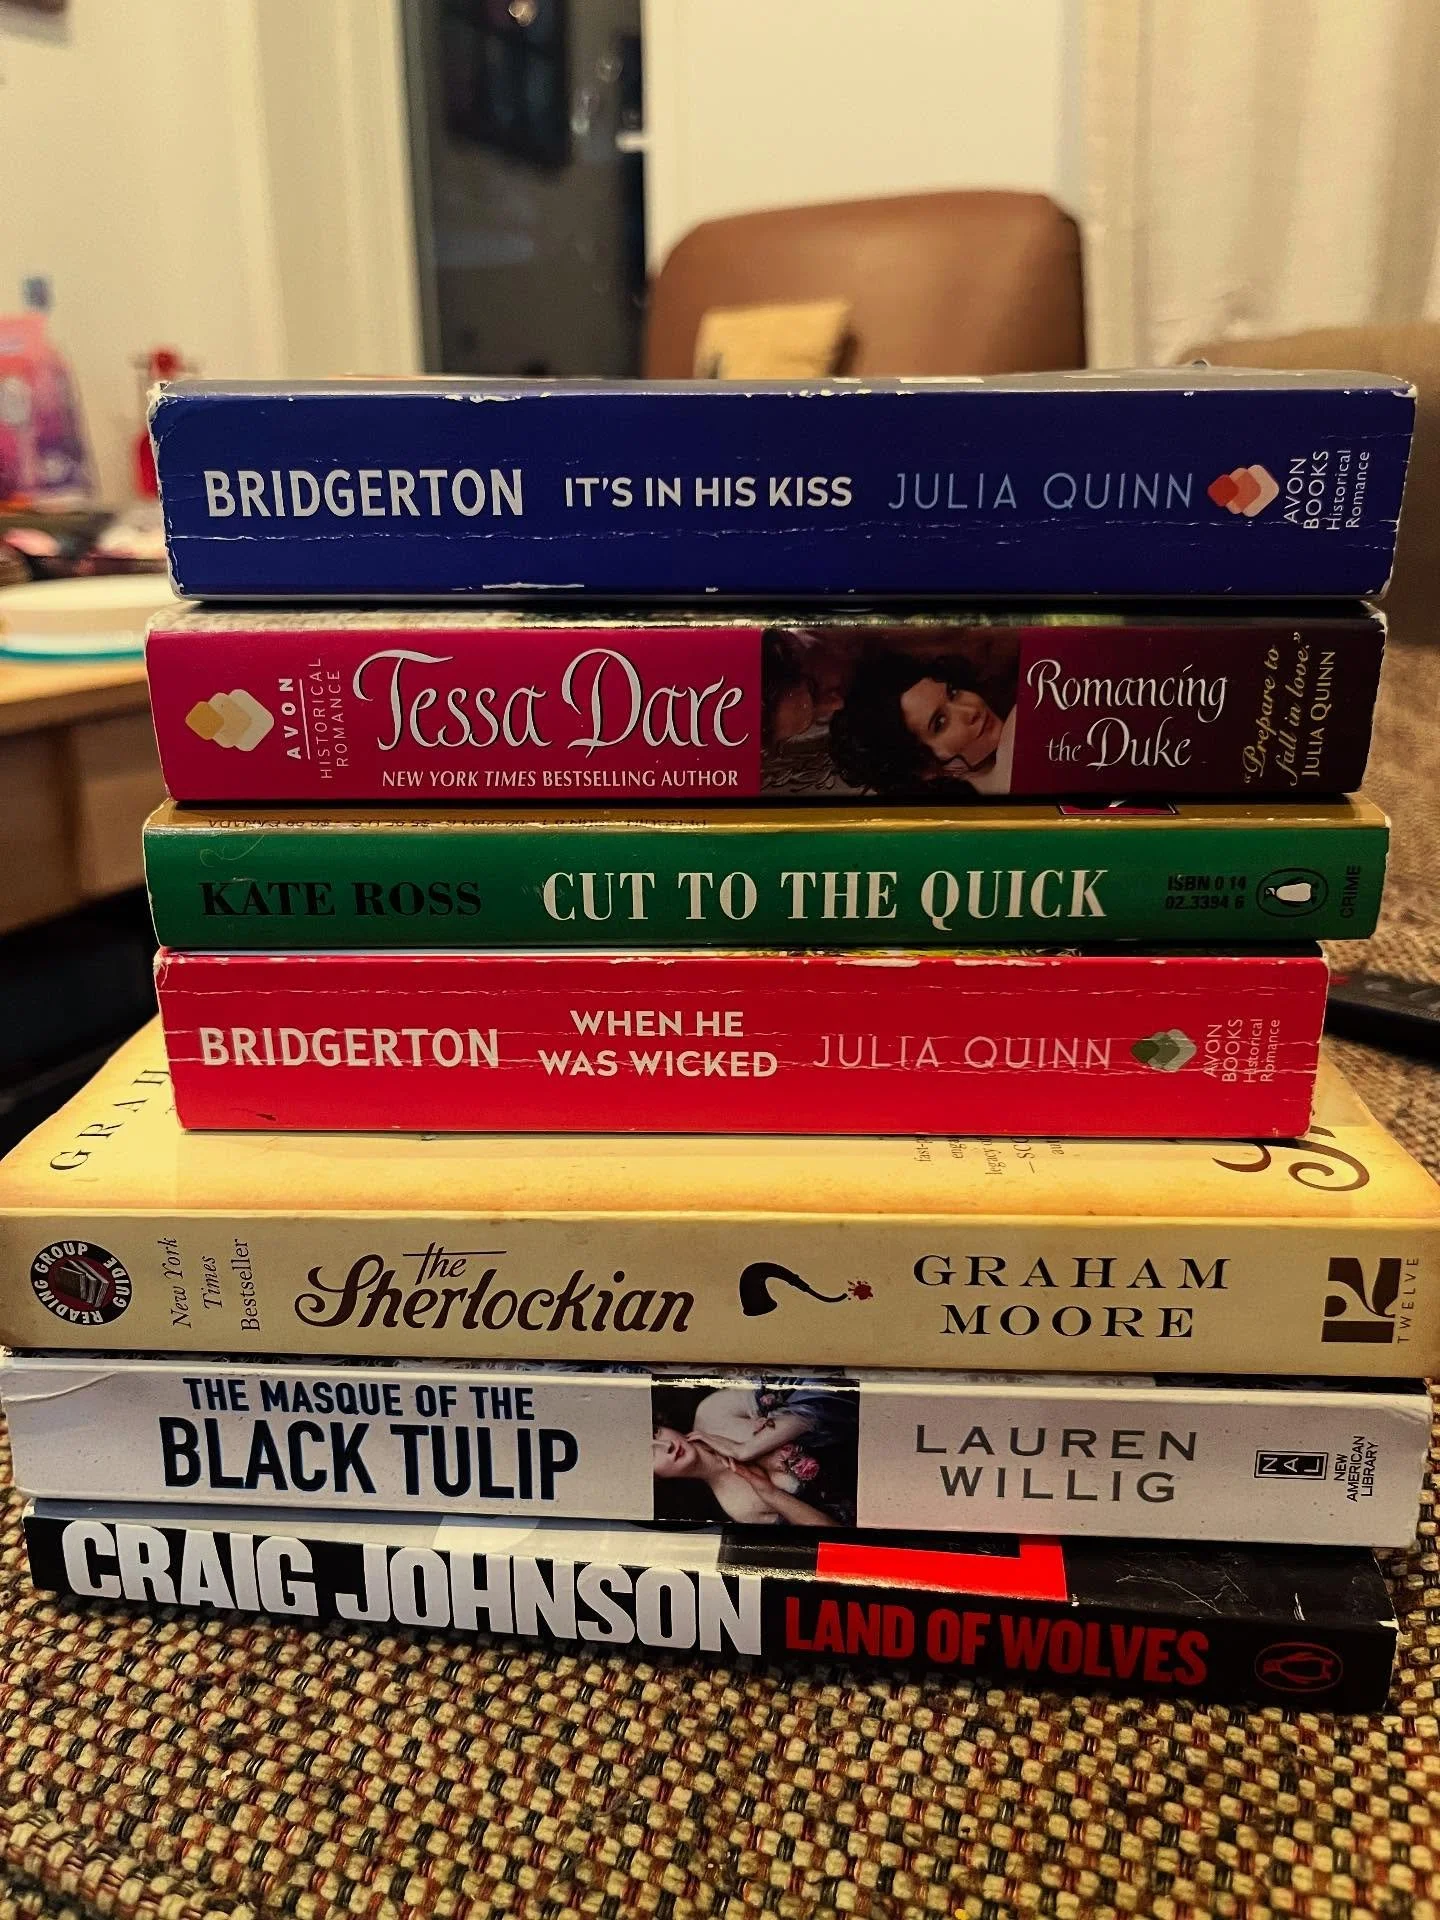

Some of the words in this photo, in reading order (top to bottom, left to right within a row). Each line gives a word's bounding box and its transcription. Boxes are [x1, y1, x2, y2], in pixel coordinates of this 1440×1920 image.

[204, 469, 524, 517] BRIDGERTON
[565, 477, 633, 507] IT'S
[645, 477, 681, 507] IN
[695, 477, 756, 507] HIS
[769, 476, 852, 507] KISS
[888, 473, 1017, 509] JULIA
[1043, 472, 1193, 509] QUINN
[1283, 458, 1307, 523] AVON
[1304, 450, 1329, 529] BOOKS
[1326, 450, 1351, 530] Historical
[1346, 452, 1370, 528] Romance
[1264, 648, 1279, 670] to
[352, 649, 553, 751] Tessa
[562, 648, 749, 758] Dare
[1027, 659, 1228, 723] Romancing
[1310, 651, 1336, 721] QUINN
[278, 678, 302, 760] AVON
[308, 658, 333, 779] HISTORICAL
[326, 671, 349, 767] ROMANCE
[1284, 703, 1301, 727] in
[1045, 731, 1082, 762] the
[1086, 717, 1191, 775] Duke
[1275, 730, 1298, 787] fall
[1301, 727, 1325, 777] JULIA
[382, 771, 424, 787] NEW
[429, 771, 479, 787] YORK
[484, 771, 536, 787] TIMES
[543, 770, 656, 787] BESTSELLING
[661, 770, 738, 787] AUTHOR
[199, 882, 335, 916] KATE
[351, 882, 482, 916] ROSS
[543, 872, 655, 921] CUT
[677, 872, 757, 921] TO
[780, 871, 898, 919] THE
[920, 869, 1108, 931] QUICK
[1168, 876, 1210, 891] ISBN
[1214, 876, 1224, 890] 0
[1231, 876, 1247, 890] 14
[1340, 864, 1360, 919] CRIME
[200, 1027, 499, 1068] BRIDGERTON
[570, 1010, 682, 1037] WHEN
[696, 1011, 744, 1037] HE
[538, 1050, 618, 1077] WAS
[629, 1050, 778, 1077] WICKED
[813, 1034, 939, 1068] JULIA
[964, 1036, 1111, 1069] QUINN
[1203, 1024, 1223, 1078] AVON
[1222, 1019, 1243, 1082] BOOKS
[1243, 1018, 1263, 1083] Historical
[1260, 1019, 1281, 1082] Romance
[50, 1069, 171, 1170] GRAH
[984, 1147, 1007, 1175] legacy
[34, 1242, 88, 1274] GROUP
[103, 1256, 132, 1307] GUIDE
[157, 1237, 183, 1279] York
[202, 1256, 223, 1309] Times
[230, 1238, 260, 1331] Bestseller
[913, 1255, 1231, 1289] GRAHAM
[34, 1278, 104, 1325] READING
[168, 1286, 191, 1329] New
[294, 1254, 695, 1332] Sherlockian
[1397, 1258, 1419, 1344] TWELVE
[939, 1304, 1194, 1338] MOORE
[183, 1378, 250, 1412] THE
[260, 1380, 403, 1416] MASQUE
[415, 1384, 457, 1418] OF
[469, 1386, 535, 1420] THE
[159, 1416, 377, 1494] BLACK
[390, 1423, 579, 1500] TULIP
[916, 1424, 1197, 1461] LAUREN
[1262, 1457, 1320, 1473] NAL
[1334, 1454, 1347, 1481] NEW
[1347, 1435, 1365, 1502] AMERICAN
[1361, 1441, 1378, 1496] LIBRARY
[940, 1465, 1175, 1503] WILLIG
[62, 1520, 319, 1616] CRAIG
[335, 1542, 762, 1655] JOHNSON
[785, 1597, 915, 1658] LAND
[926, 1609, 990, 1665] OF
[999, 1613, 1209, 1685] WOLVES
